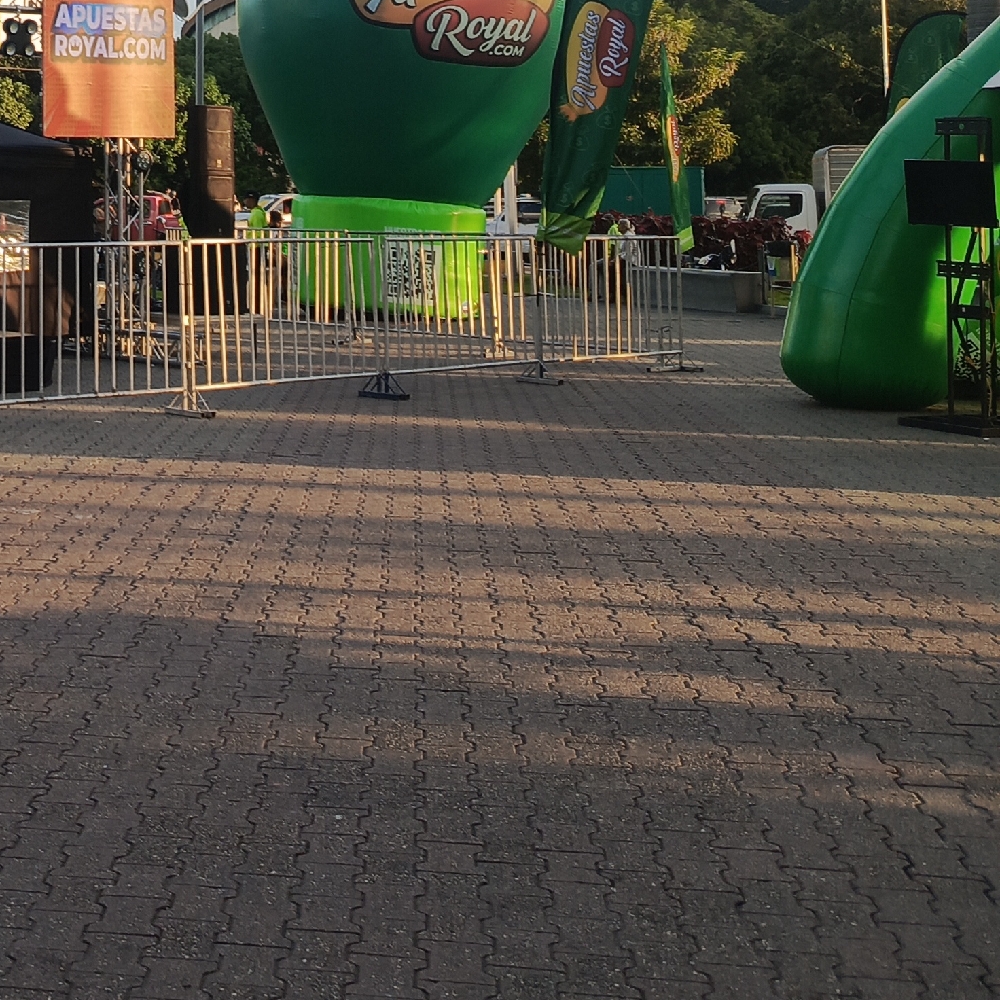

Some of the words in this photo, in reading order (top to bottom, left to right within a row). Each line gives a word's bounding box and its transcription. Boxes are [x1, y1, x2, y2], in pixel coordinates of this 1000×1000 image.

[55, 3, 166, 32] APUESTAS
[426, 4, 537, 57] Royal
[54, 34, 166, 60] ROYAL.COM
[489, 43, 526, 57] .COM
[571, 9, 601, 112] Apuestas
[599, 16, 630, 78] Royal
